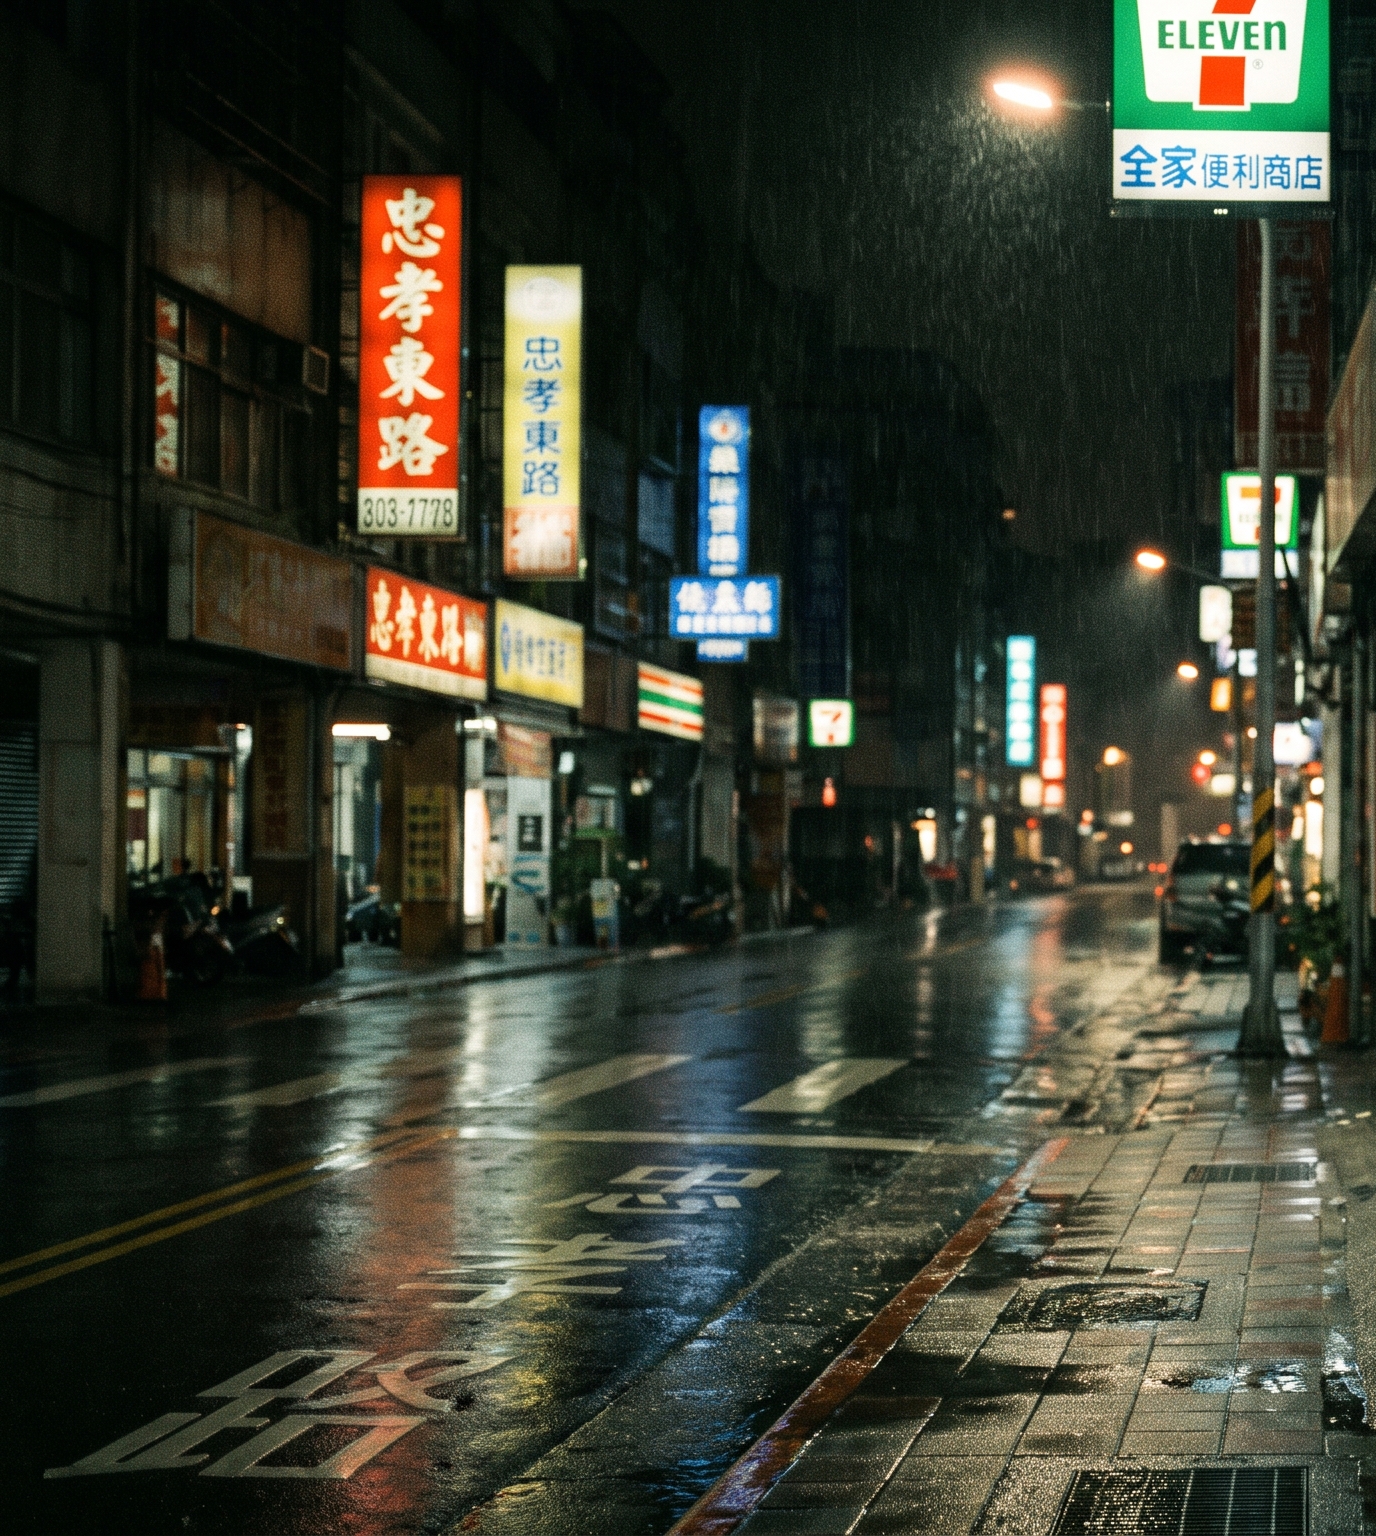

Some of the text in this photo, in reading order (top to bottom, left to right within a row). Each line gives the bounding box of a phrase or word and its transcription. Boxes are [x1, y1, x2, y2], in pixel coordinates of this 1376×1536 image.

[1119, 144, 1323, 190] 全家便利商店
[378, 187, 449, 476] 忠孝東路
[522, 335, 562, 497] 忠孝東路
